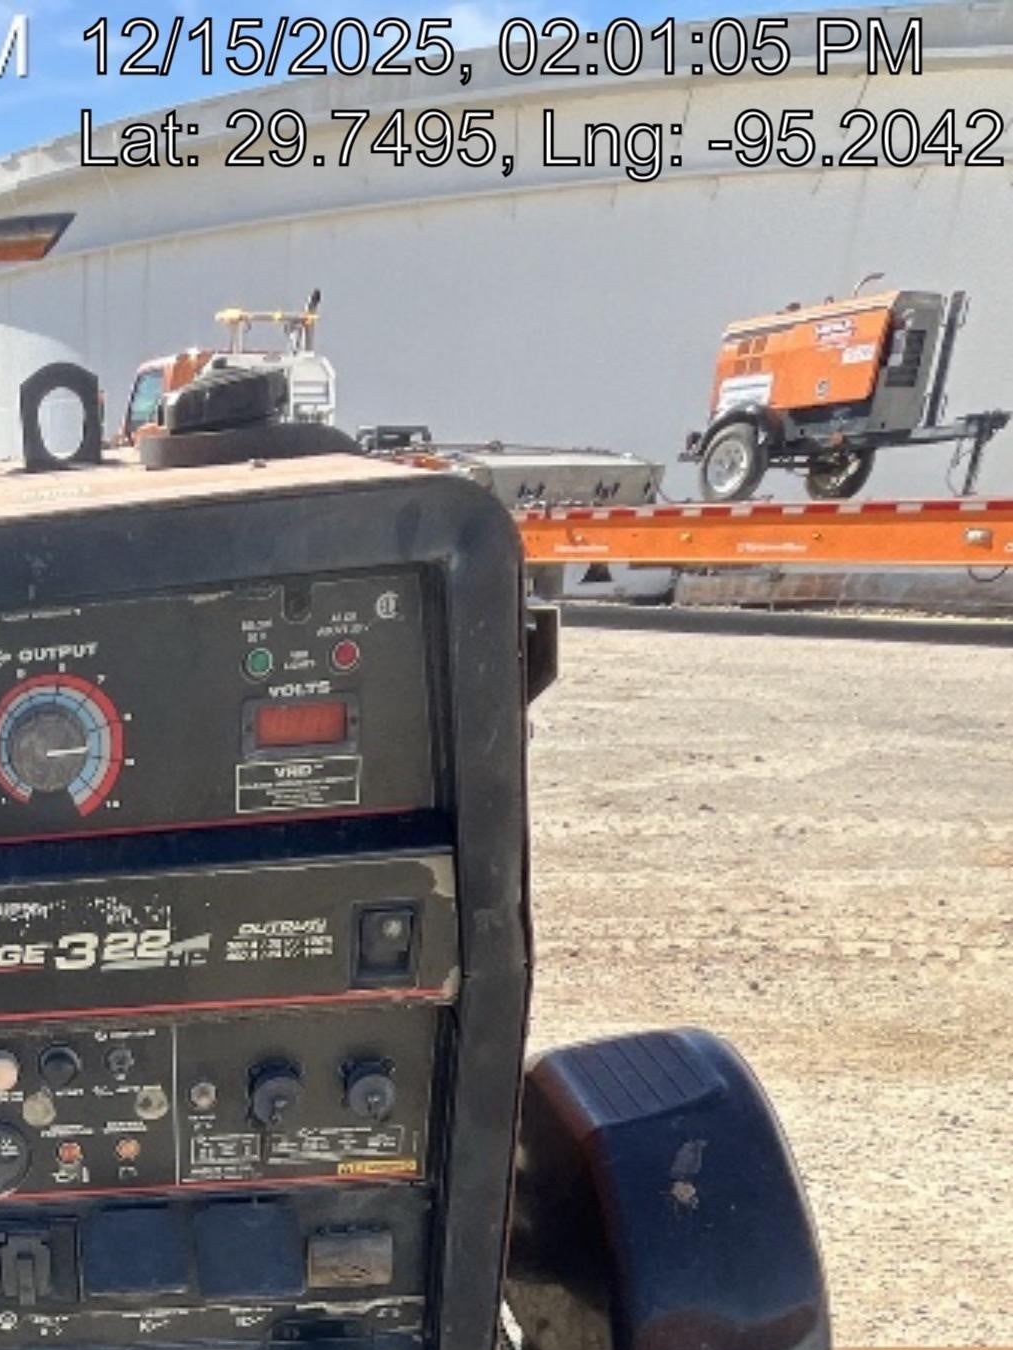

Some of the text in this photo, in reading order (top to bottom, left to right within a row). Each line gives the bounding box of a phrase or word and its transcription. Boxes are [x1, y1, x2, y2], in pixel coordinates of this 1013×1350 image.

[19, 642, 98, 662] OUTPUT
[268, 680, 332, 697] VOLTS
[55, 928, 171, 970] 322
